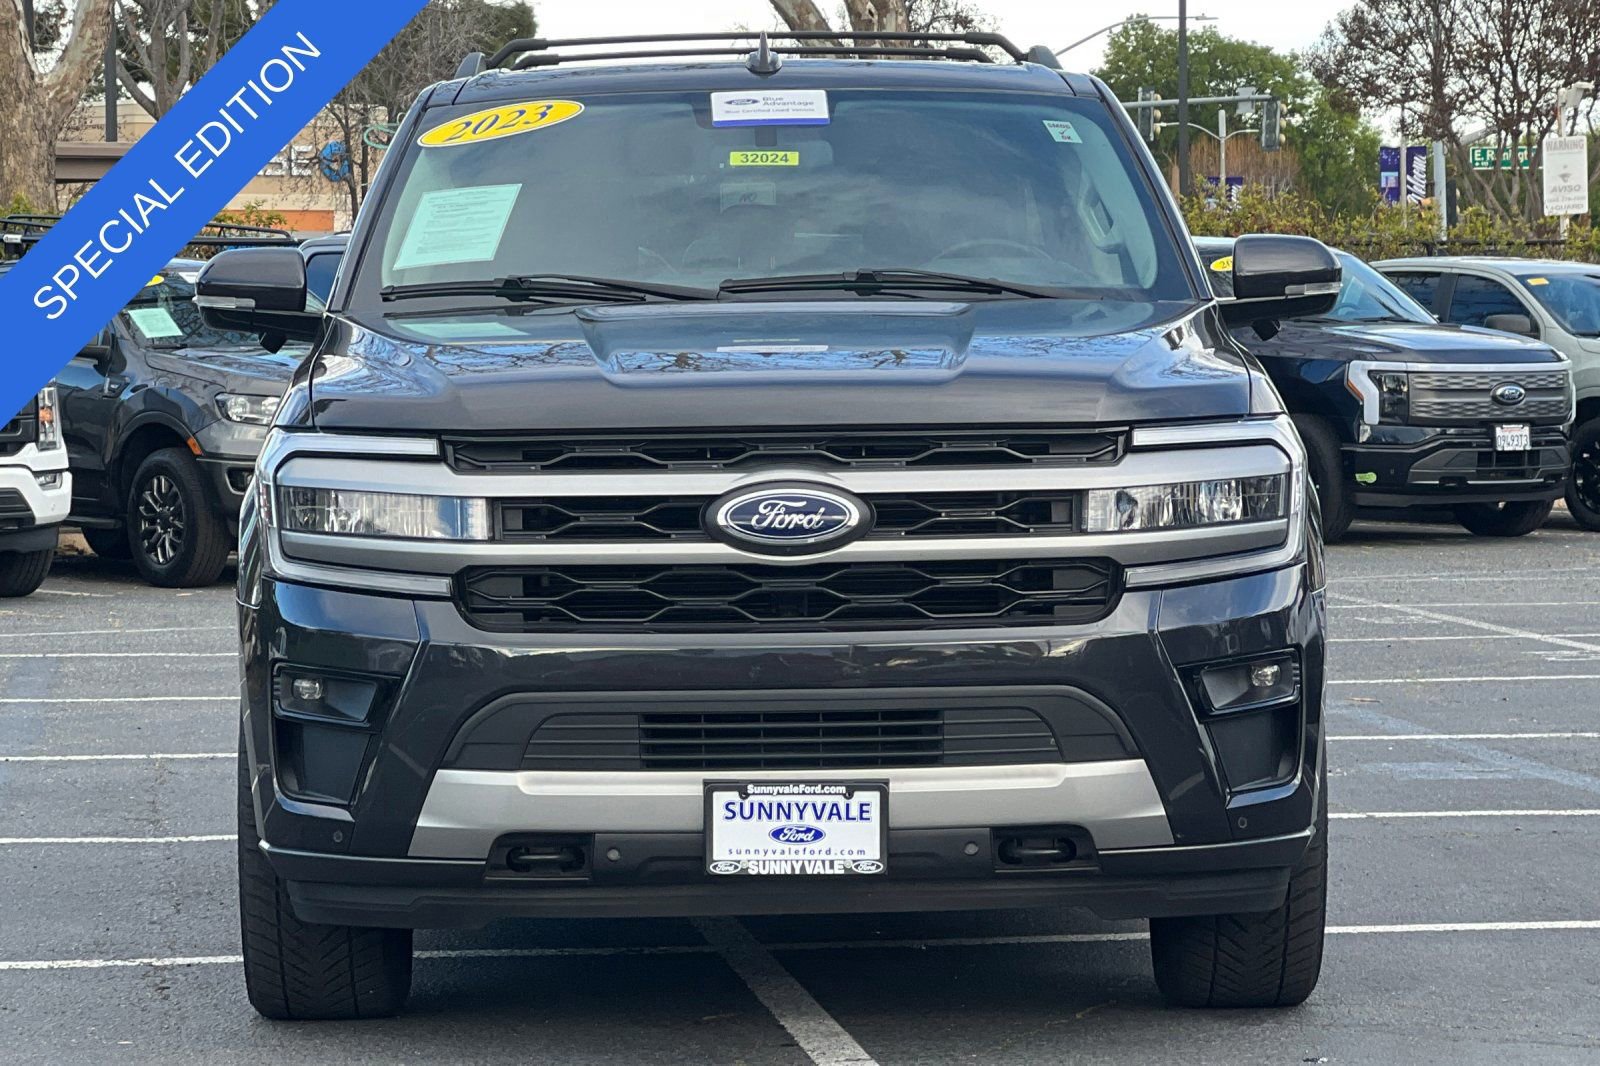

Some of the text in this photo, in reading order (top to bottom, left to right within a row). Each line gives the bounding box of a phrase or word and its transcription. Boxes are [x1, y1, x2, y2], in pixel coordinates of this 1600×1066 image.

[442, 104, 554, 142] 2023
[1546, 139, 1585, 152] WARNING
[740, 153, 789, 163] 32024
[1474, 149, 1484, 161] E.
[1551, 184, 1582, 193] AVISO
[751, 500, 826, 530] Ford
[747, 784, 846, 796] SunnyvaleFord.com
[725, 801, 871, 821] SUNNYVALE
[780, 826, 814, 842] Ford
[728, 847, 866, 857] sunnyvaleford.com
[748, 860, 845, 875] SUNNYVALE
